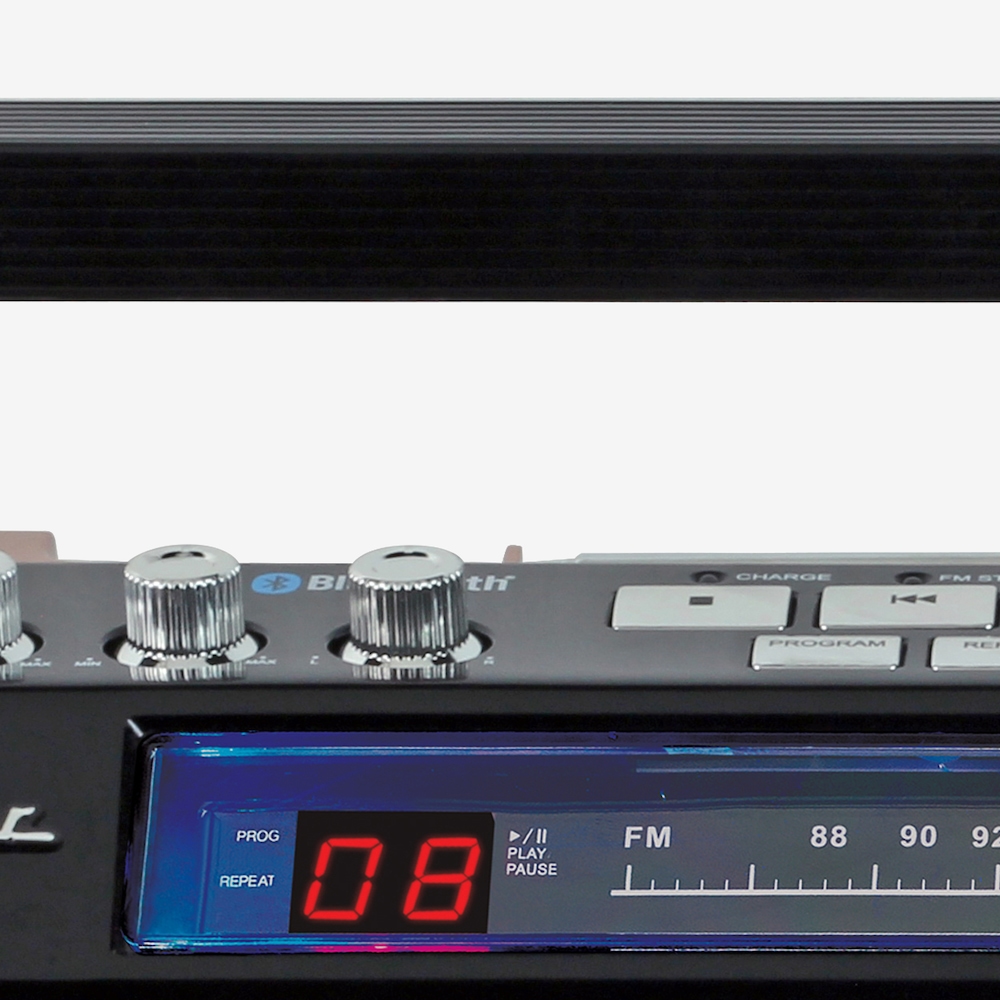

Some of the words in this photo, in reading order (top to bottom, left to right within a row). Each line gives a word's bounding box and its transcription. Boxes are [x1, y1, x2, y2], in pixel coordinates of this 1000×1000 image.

[736, 573, 832, 581] CHARGE
[938, 574, 970, 582] FM
[768, 639, 887, 648] PROGRAM
[236, 829, 280, 843] PROG
[624, 826, 671, 848] FM
[810, 825, 848, 848] 88
[900, 825, 937, 848] 90
[507, 847, 547, 860] PLAY
[506, 862, 558, 876] PAUSE
[219, 874, 275, 888] REPEAT
[303, 837, 482, 922] 08
